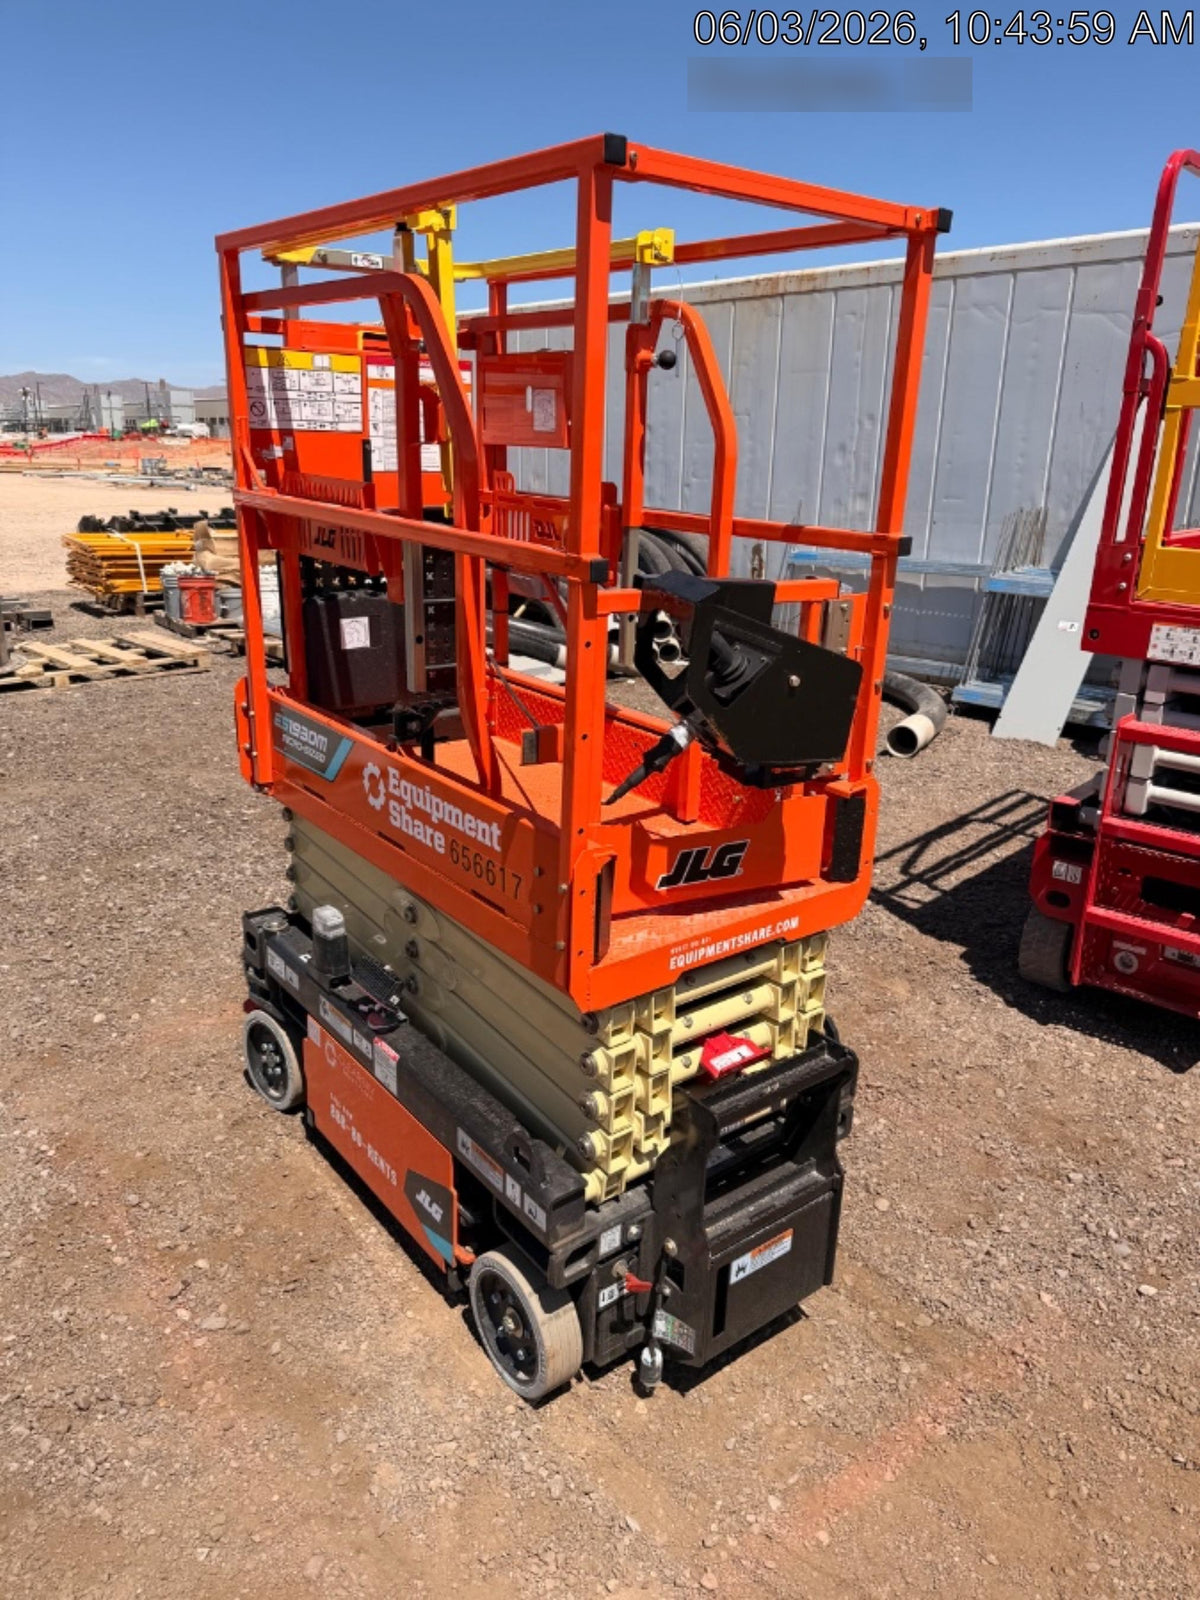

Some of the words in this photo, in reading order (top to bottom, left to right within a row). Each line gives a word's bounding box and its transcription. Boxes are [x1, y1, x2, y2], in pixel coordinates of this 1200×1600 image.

[387, 766, 501, 853] Equipment
[388, 799, 446, 854] Share
[449, 838, 522, 900] 656617
[655, 838, 751, 891] JLG
[669, 916, 800, 971] EQUIPMENTSHARE.COM
[415, 1189, 444, 1223] JLG
